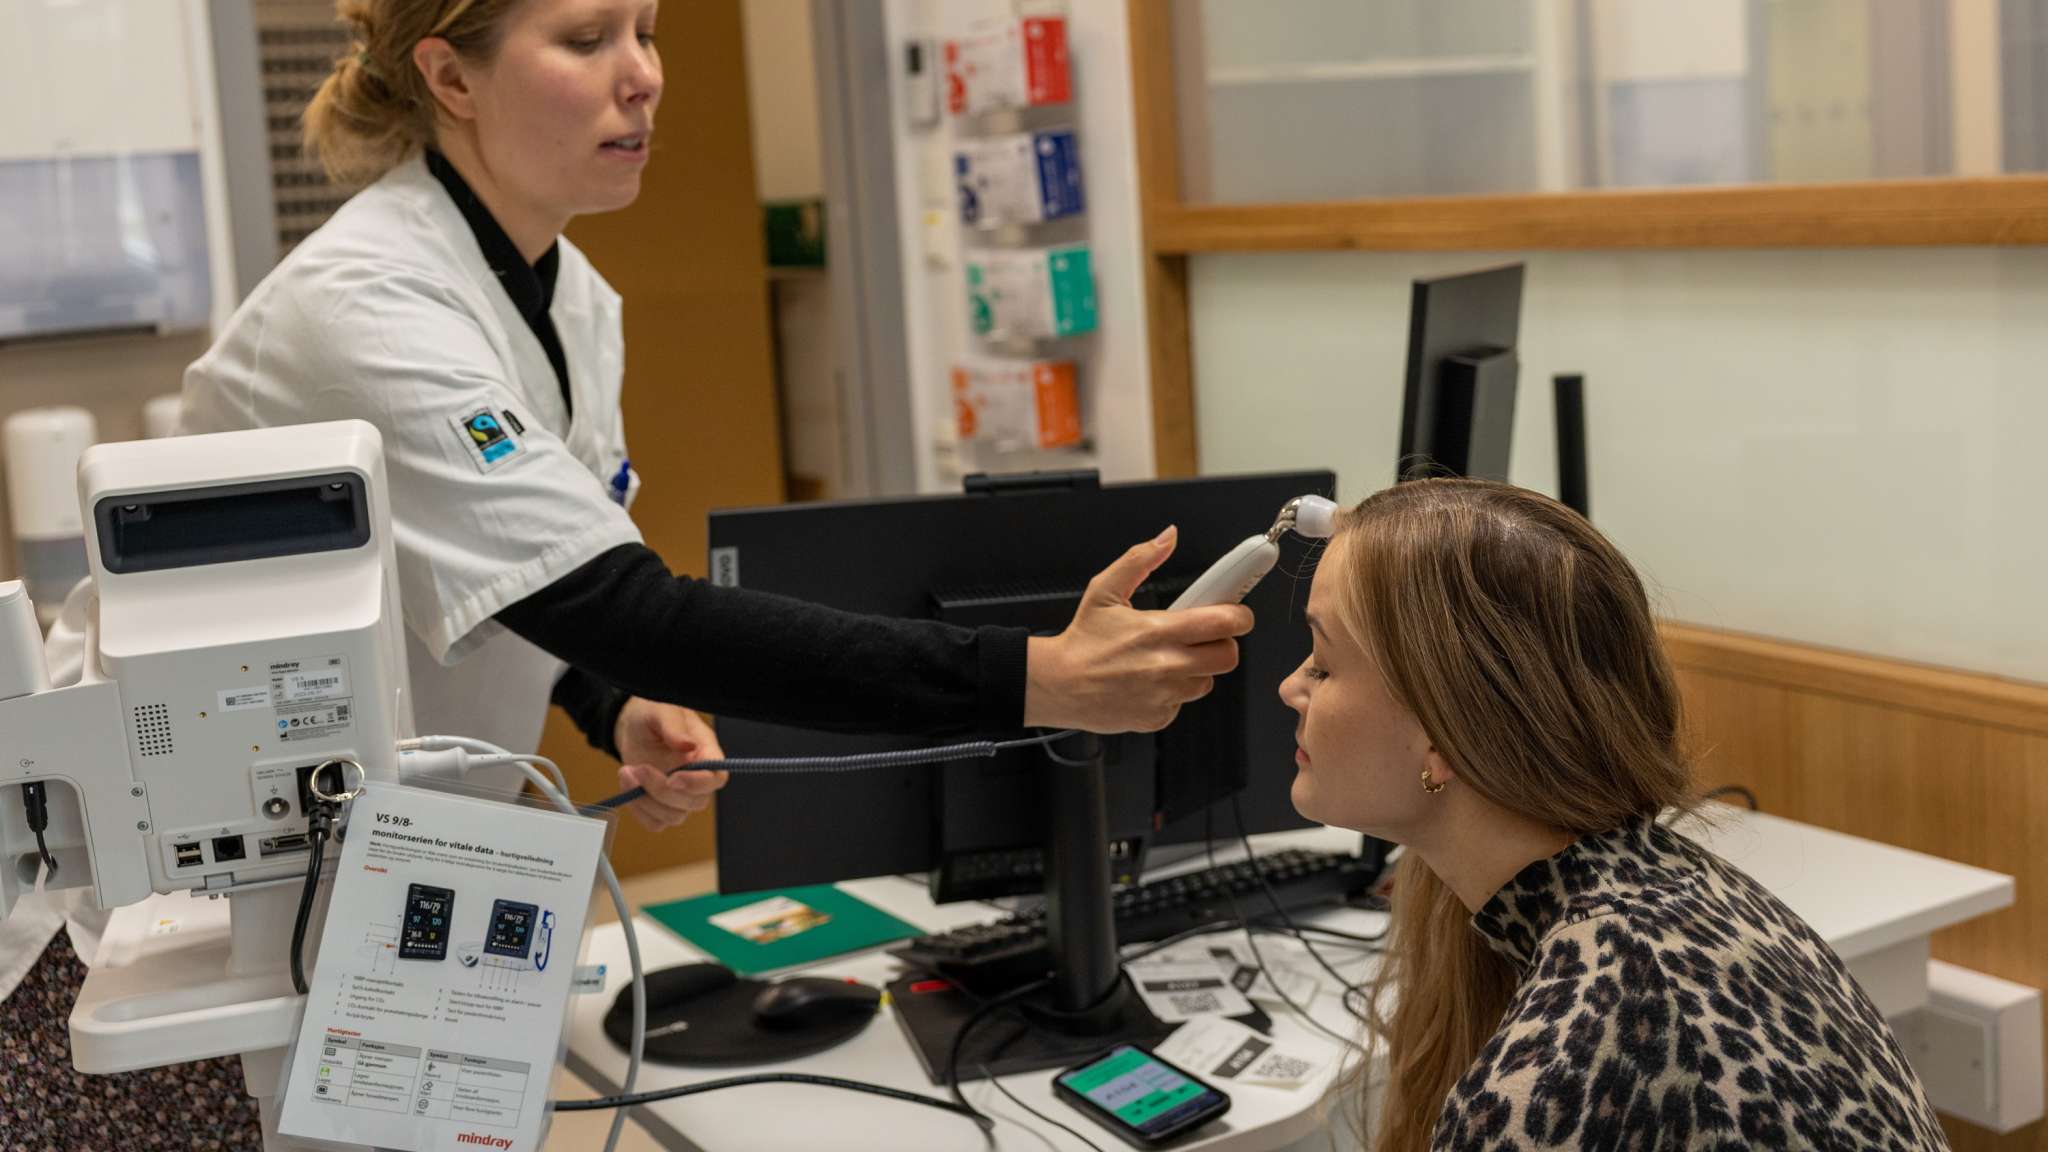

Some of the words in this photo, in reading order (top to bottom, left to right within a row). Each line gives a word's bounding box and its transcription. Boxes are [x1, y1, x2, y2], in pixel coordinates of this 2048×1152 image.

[270, 661, 300, 671] mindray
[376, 812, 390, 824] VS
[392, 816, 414, 827] 9/8-
[372, 829, 434, 846] monitorserien
[435, 838, 448, 847] for
[449, 840, 474, 852] vitale
[474, 845, 494, 856] data
[456, 1131, 514, 1152] mindray
